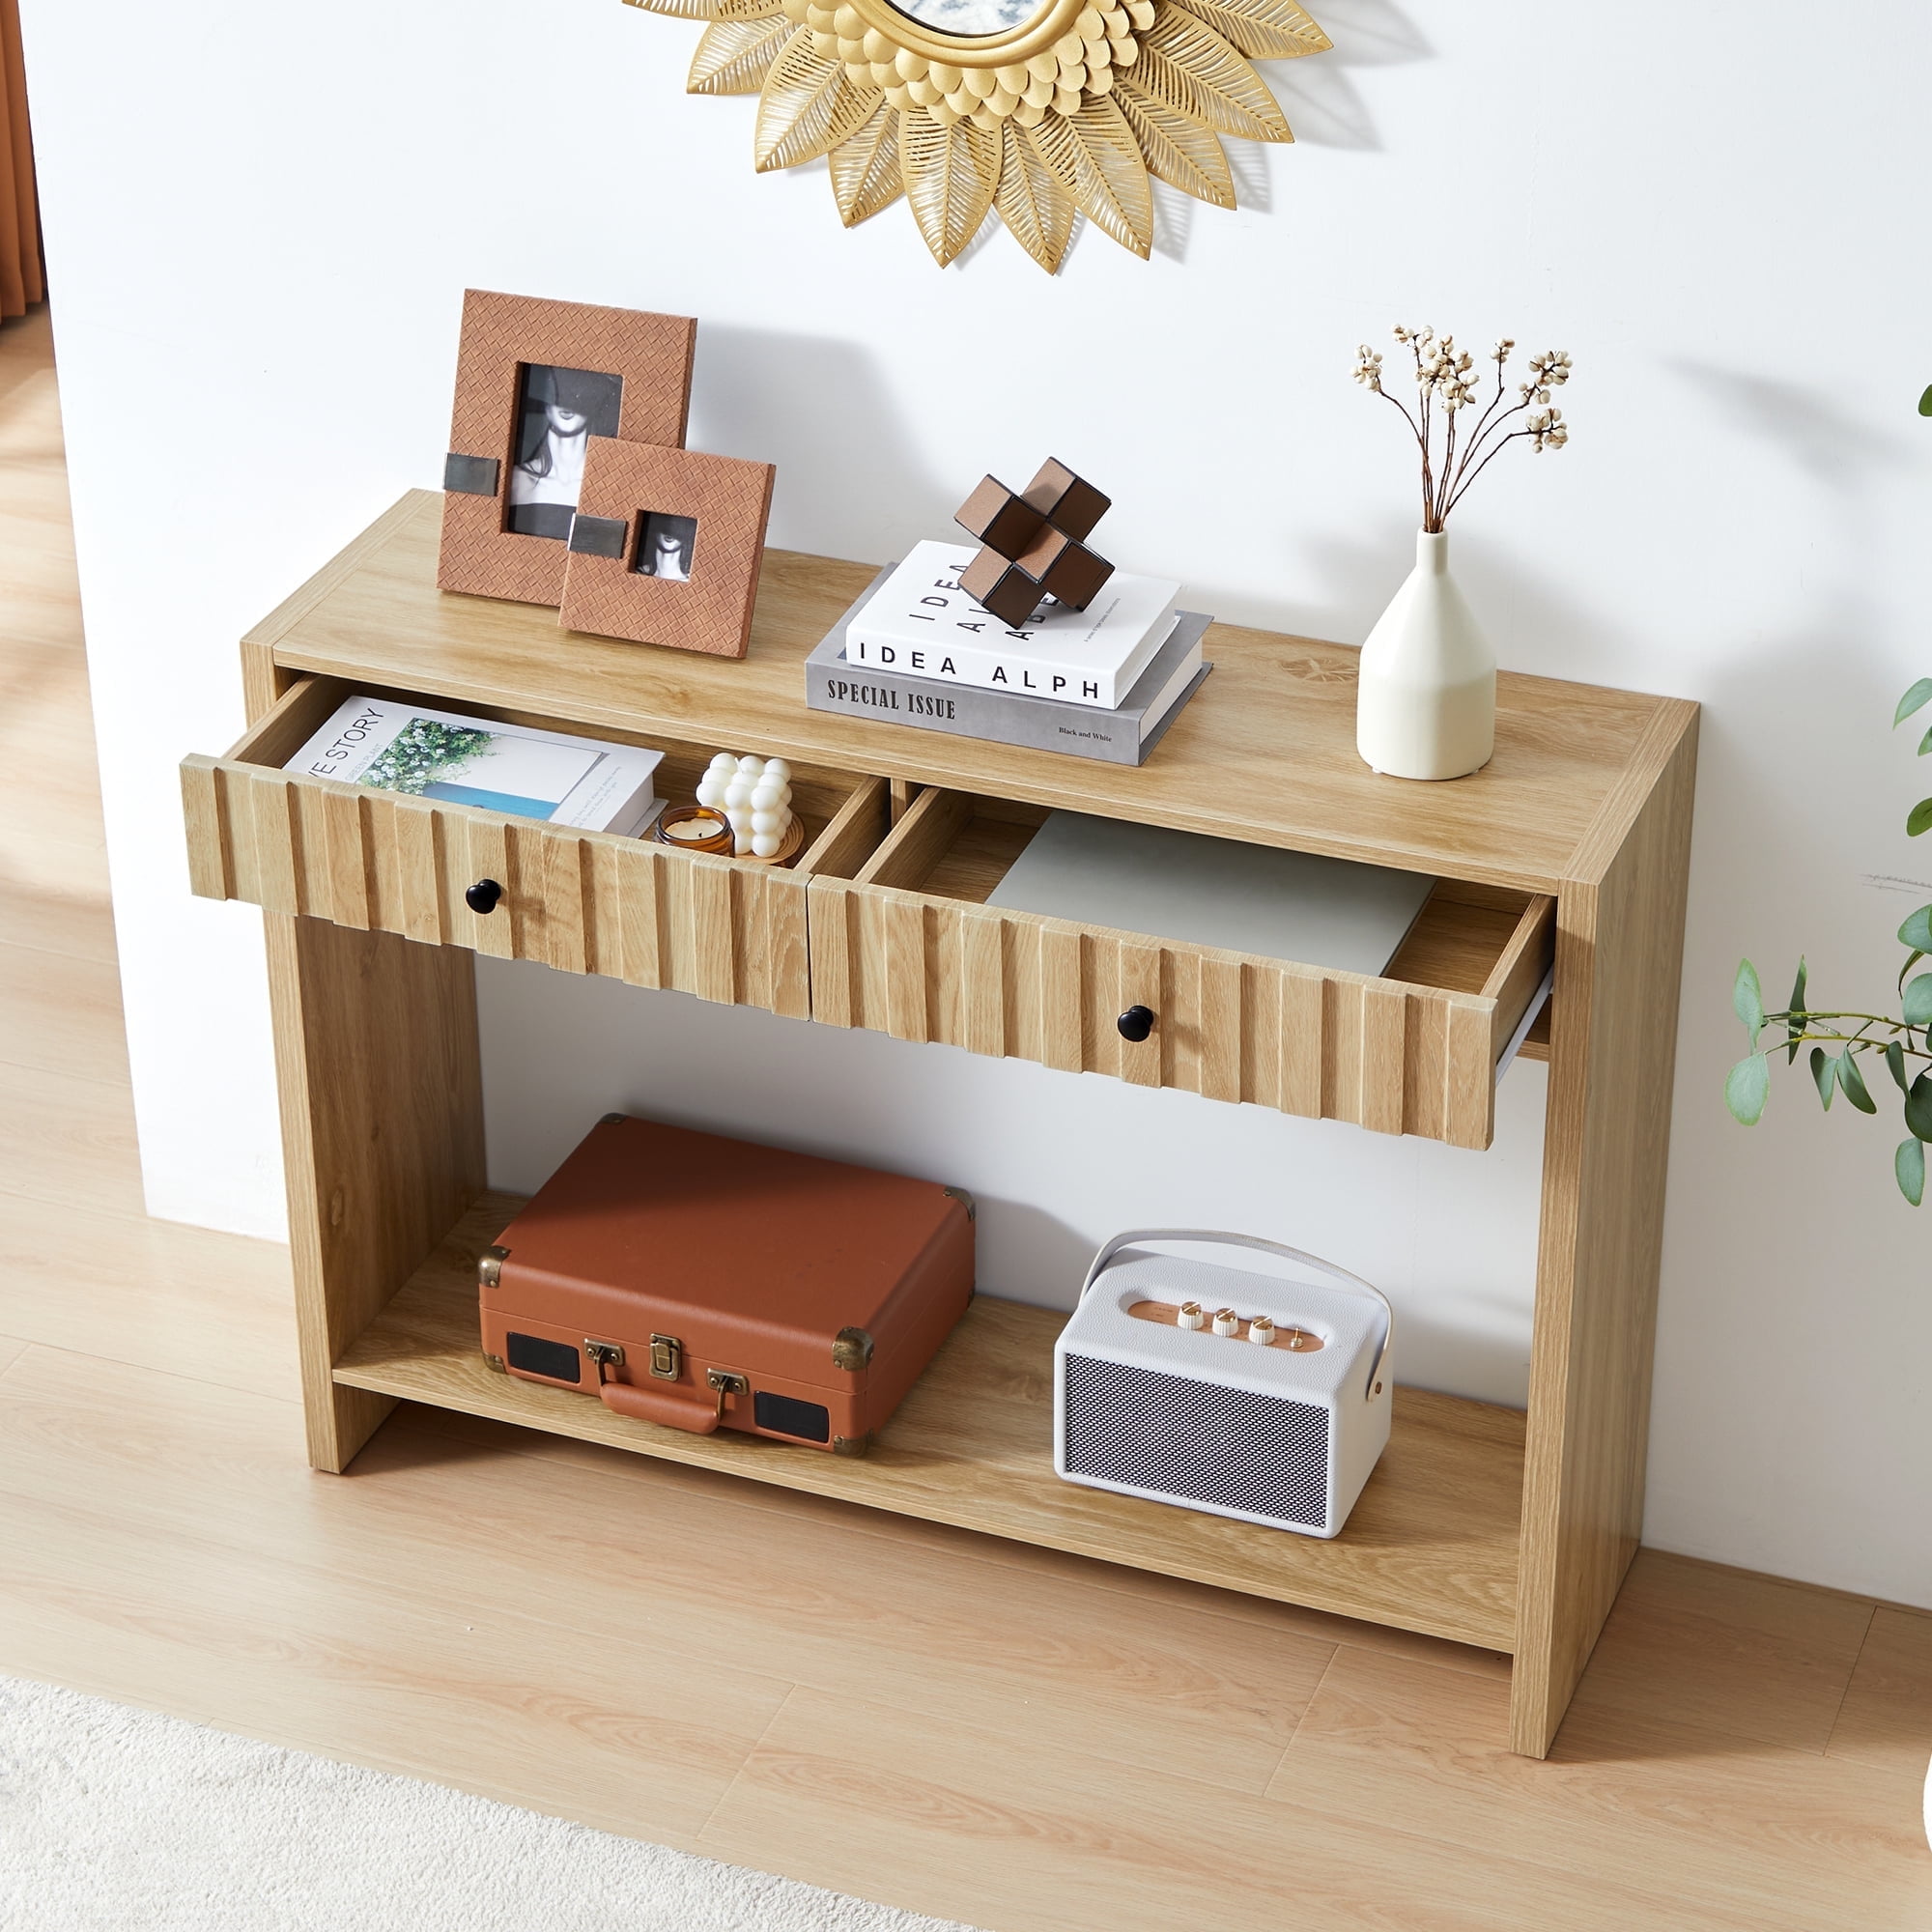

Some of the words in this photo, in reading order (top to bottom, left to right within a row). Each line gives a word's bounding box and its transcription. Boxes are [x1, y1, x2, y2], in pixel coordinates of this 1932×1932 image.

[860, 641, 956, 675] IDEA
[991, 666, 1099, 699] ALPH
[827, 679, 899, 710] SPECIAL
[908, 693, 956, 721] ISSUE
[325, 707, 384, 760] STORY
[1059, 726, 1078, 736] Black
[1093, 732, 1113, 743] White
